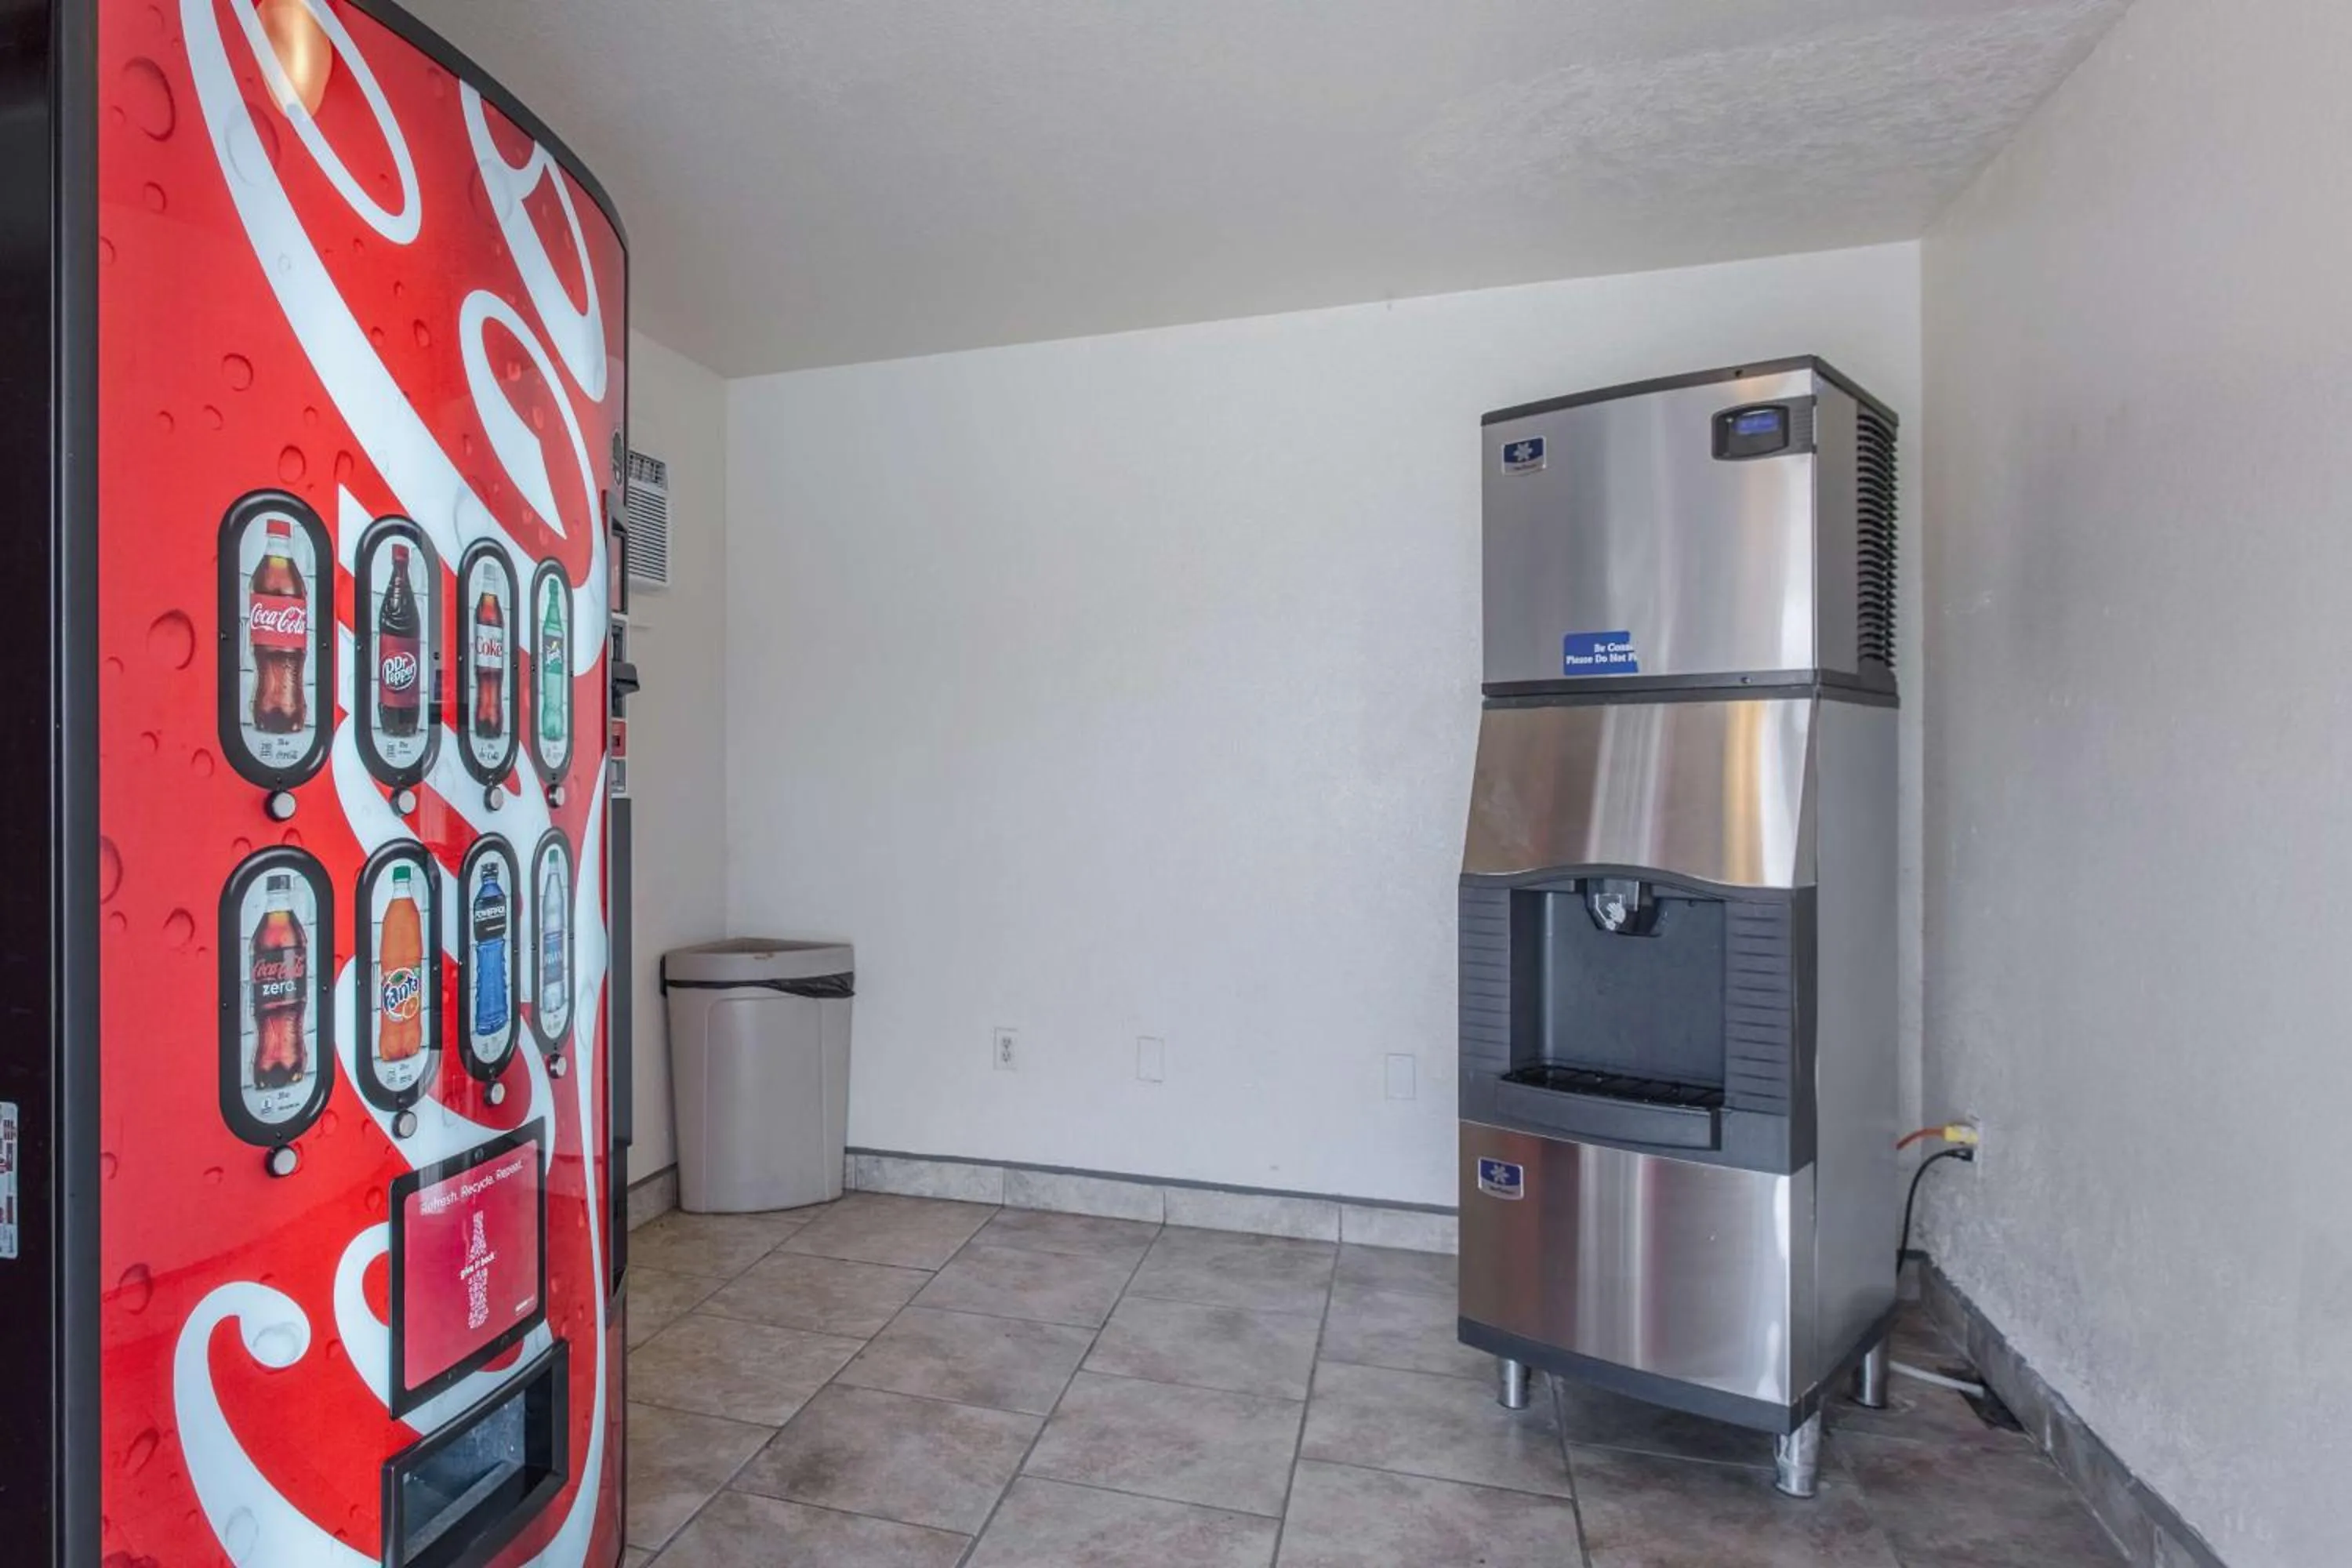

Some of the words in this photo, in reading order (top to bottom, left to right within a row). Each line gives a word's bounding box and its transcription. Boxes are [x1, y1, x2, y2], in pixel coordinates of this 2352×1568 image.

[250, 602, 306, 634] Coca-Cola
[475, 636, 503, 658] Coke
[1566, 655, 1593, 664] Please
[1595, 653, 1607, 663] Do
[1610, 653, 1626, 662] Not
[383, 659, 415, 685] Pepper
[394, 656, 408, 670] Dr
[383, 974, 419, 1014] Fanta
